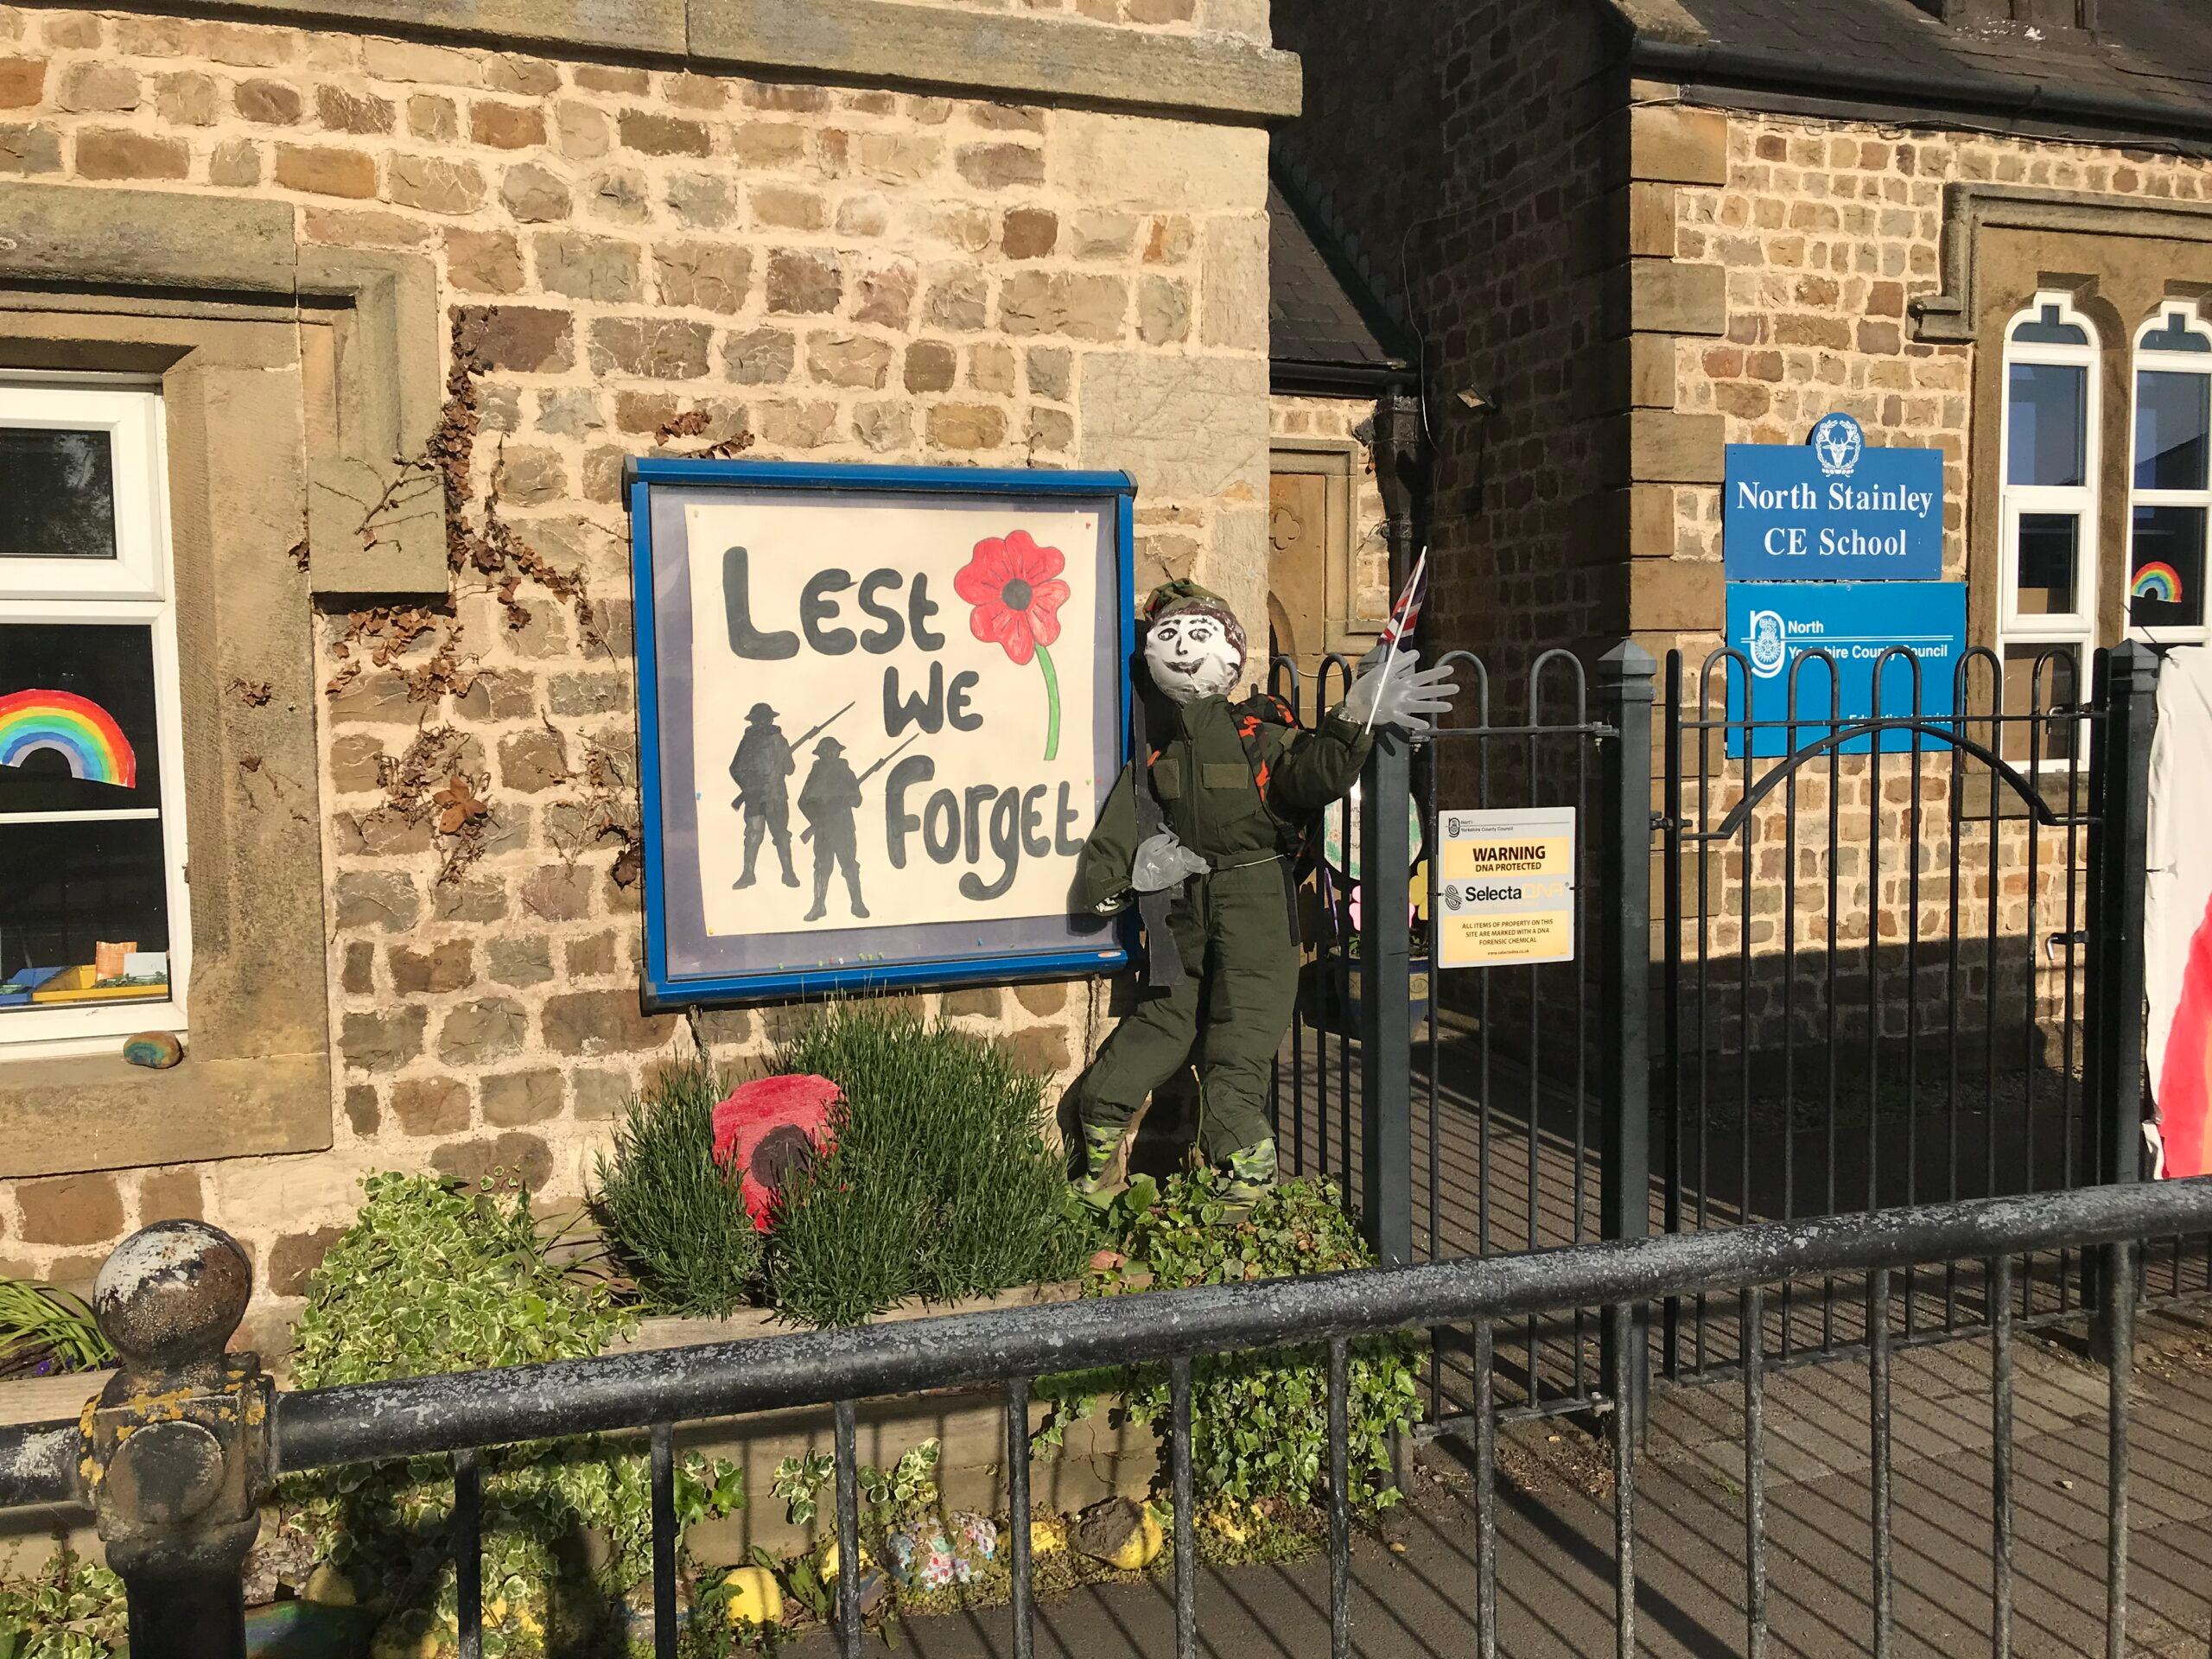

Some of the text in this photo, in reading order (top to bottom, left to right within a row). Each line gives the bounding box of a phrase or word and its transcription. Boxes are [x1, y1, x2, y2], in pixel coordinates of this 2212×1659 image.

[1737, 481, 1933, 518] North Stainley
[1764, 527, 1907, 556] CE School
[1788, 620, 1824, 634] North
[1472, 846, 1546, 861] WARNING
[1476, 861, 1542, 873] DNA PROTECTED
